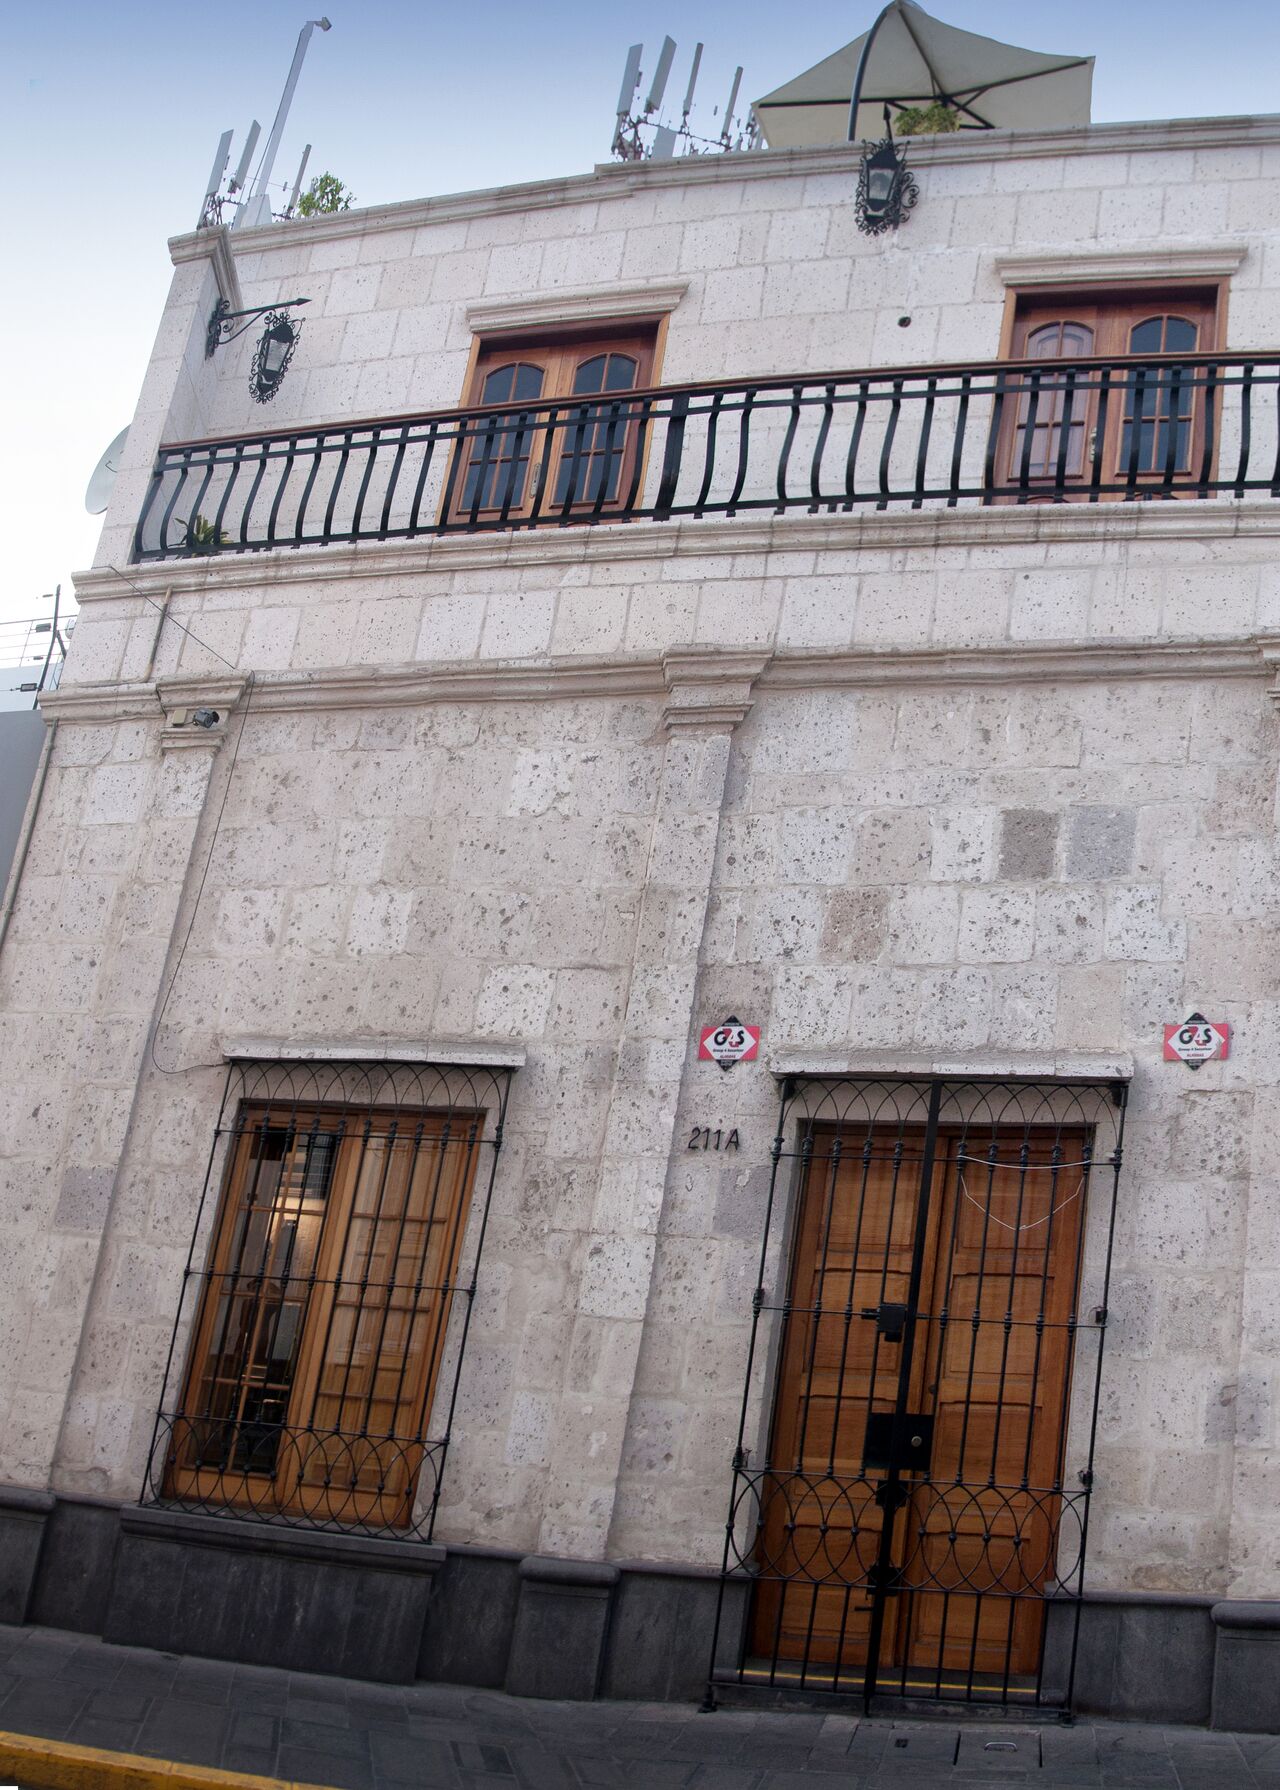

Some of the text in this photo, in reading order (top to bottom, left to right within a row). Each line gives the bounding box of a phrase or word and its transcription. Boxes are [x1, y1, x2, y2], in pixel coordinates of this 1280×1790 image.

[714, 1028, 745, 1048] G4S
[1179, 1026, 1213, 1046] G4S
[688, 1127, 740, 1150] 211A
